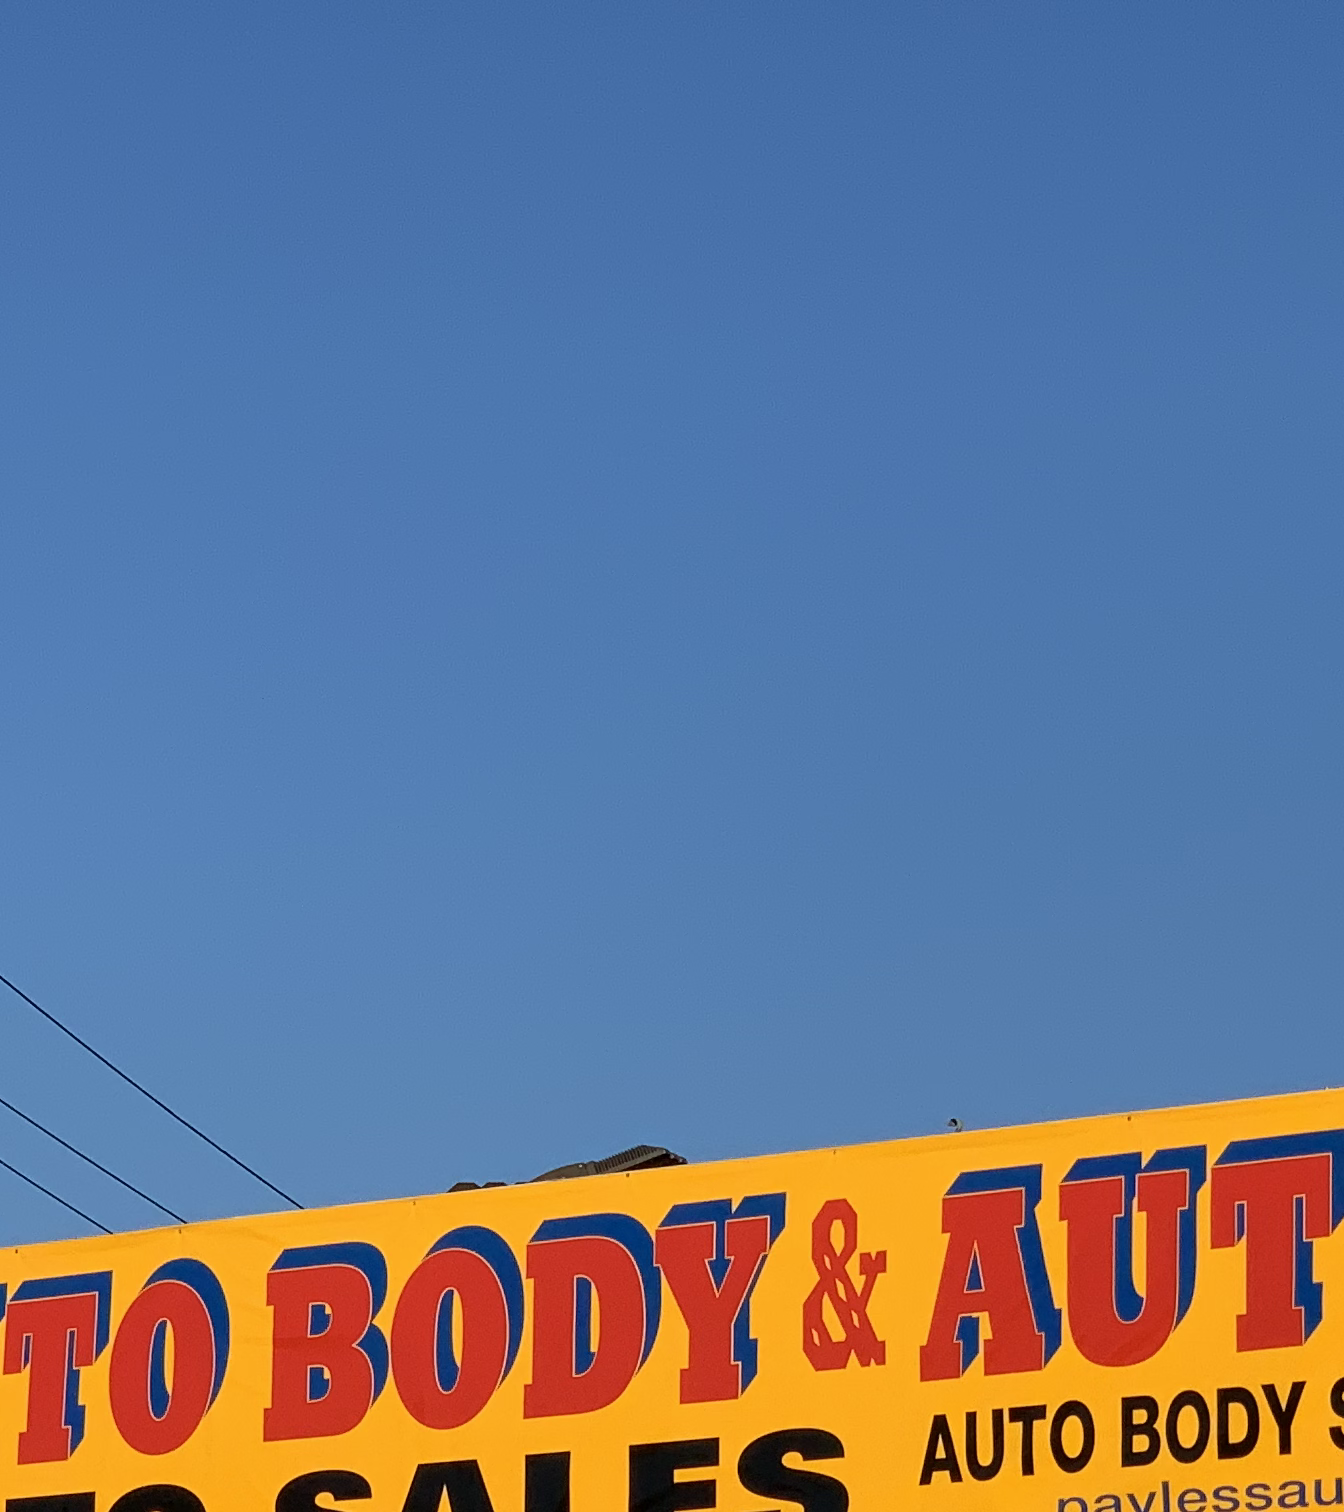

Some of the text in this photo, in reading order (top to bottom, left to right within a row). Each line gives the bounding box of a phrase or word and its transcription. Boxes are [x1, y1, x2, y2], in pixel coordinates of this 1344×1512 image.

[263, 1192, 787, 1442] BODY
[803, 1199, 887, 1372] &
[919, 1397, 1094, 1487] AUTO
[1122, 1378, 1303, 1467] BODY
